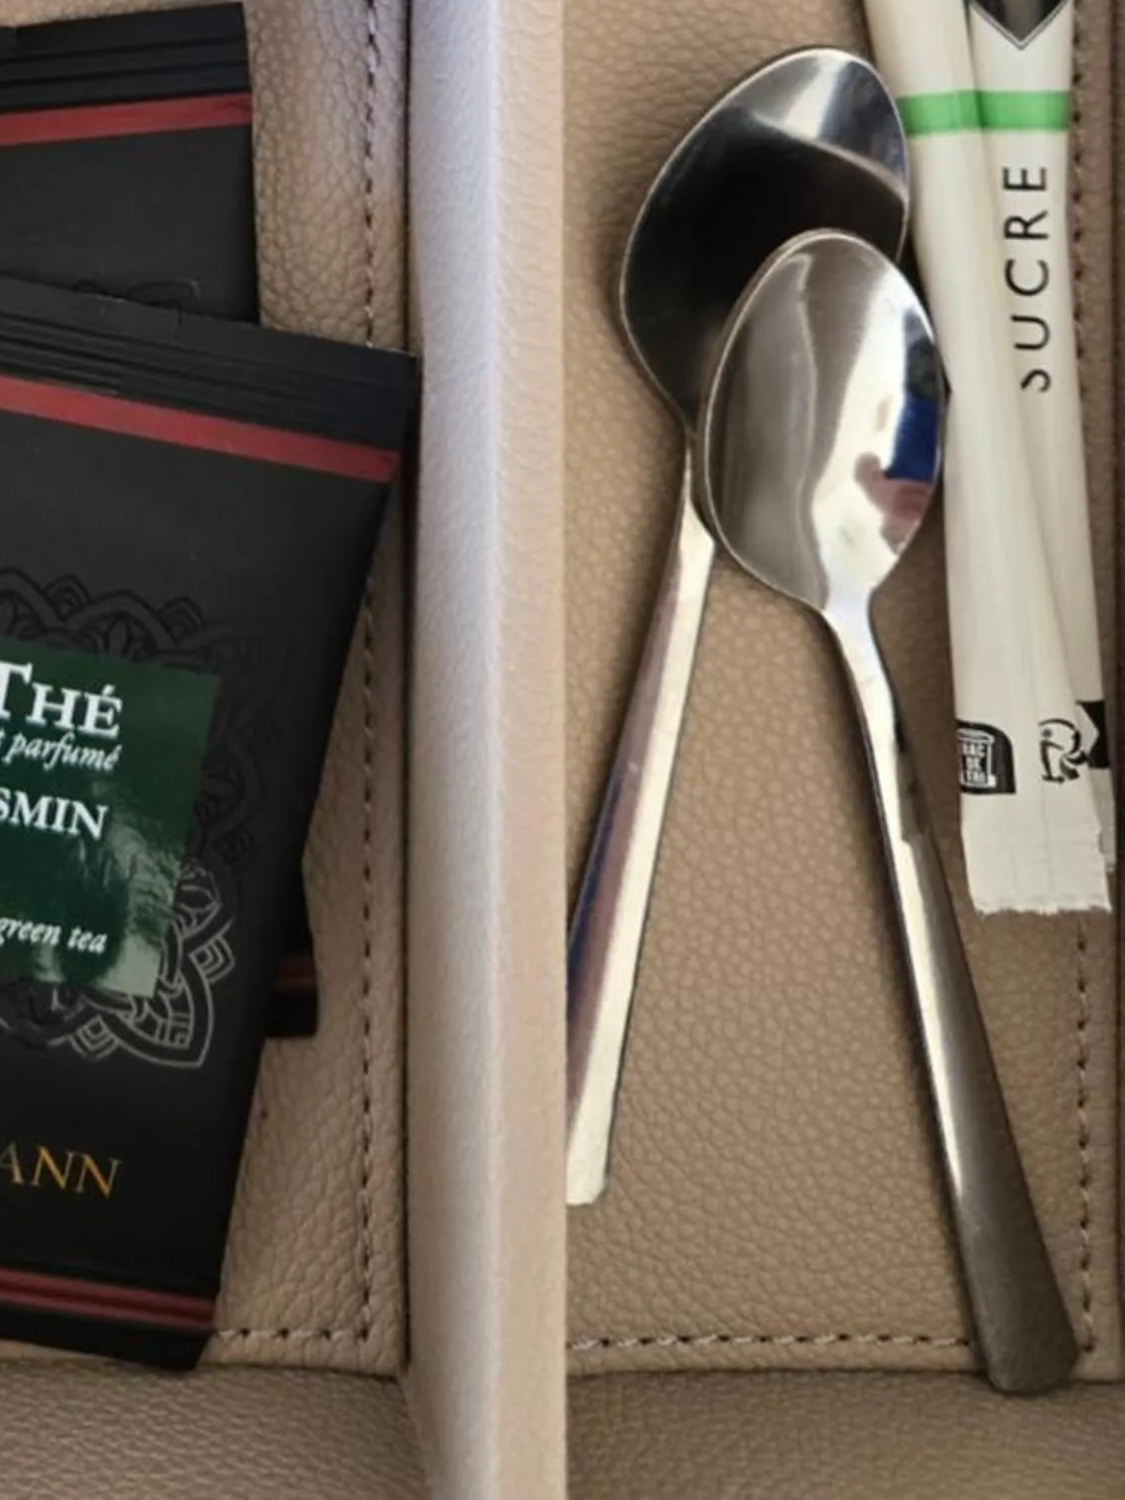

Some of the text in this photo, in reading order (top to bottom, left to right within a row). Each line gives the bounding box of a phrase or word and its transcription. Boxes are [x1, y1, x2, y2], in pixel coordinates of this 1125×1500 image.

[1003, 166, 1051, 392] SUCRE
[2, 730, 123, 772] parfumé
[66, 926, 108, 955] tea
